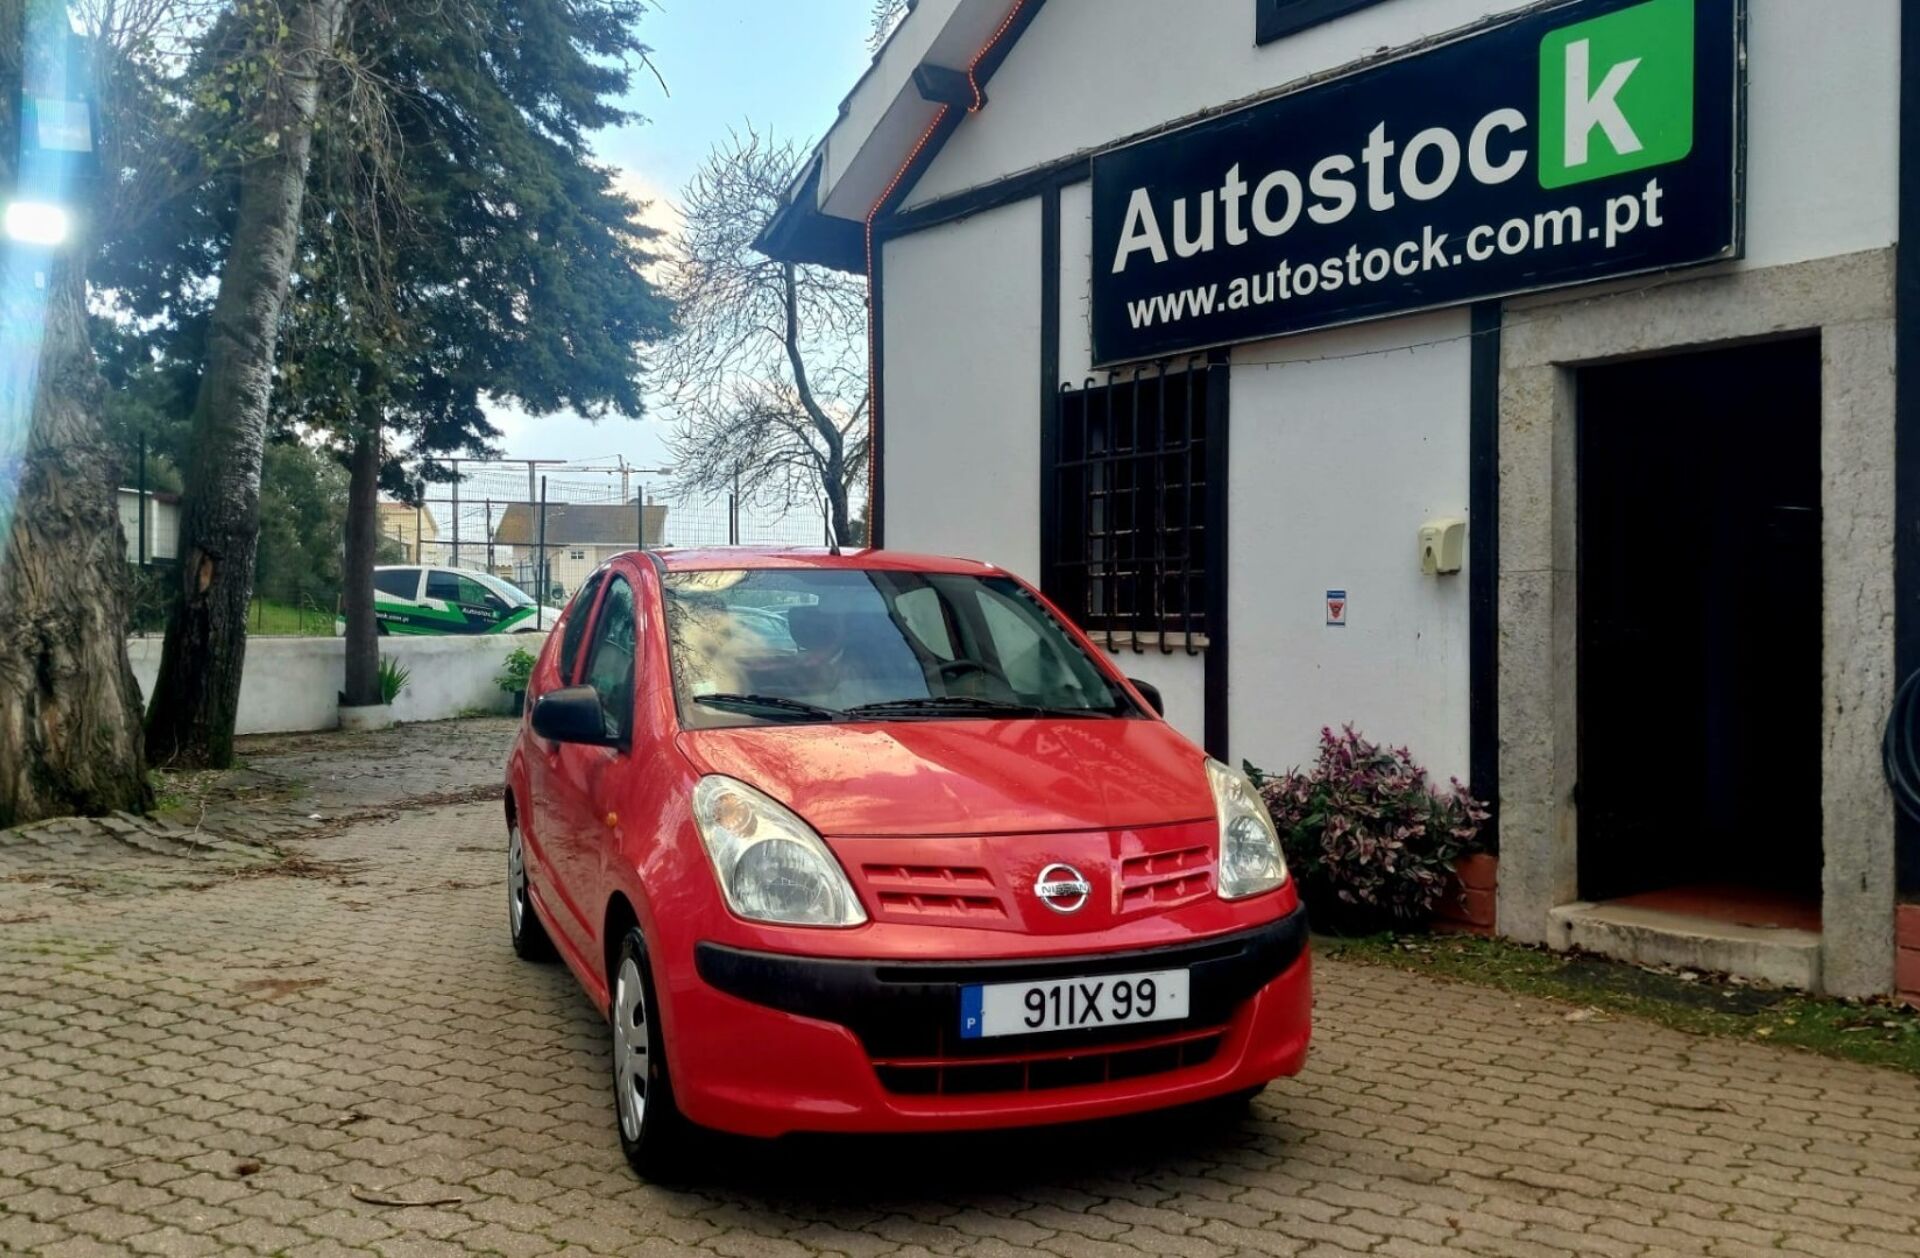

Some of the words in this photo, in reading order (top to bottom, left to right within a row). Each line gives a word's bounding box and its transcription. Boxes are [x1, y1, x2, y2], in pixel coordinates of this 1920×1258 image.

[1112, 39, 1642, 274] Autostock
[1127, 178, 1664, 329] www.autostock.com.pt
[967, 1018, 976, 1029] P
